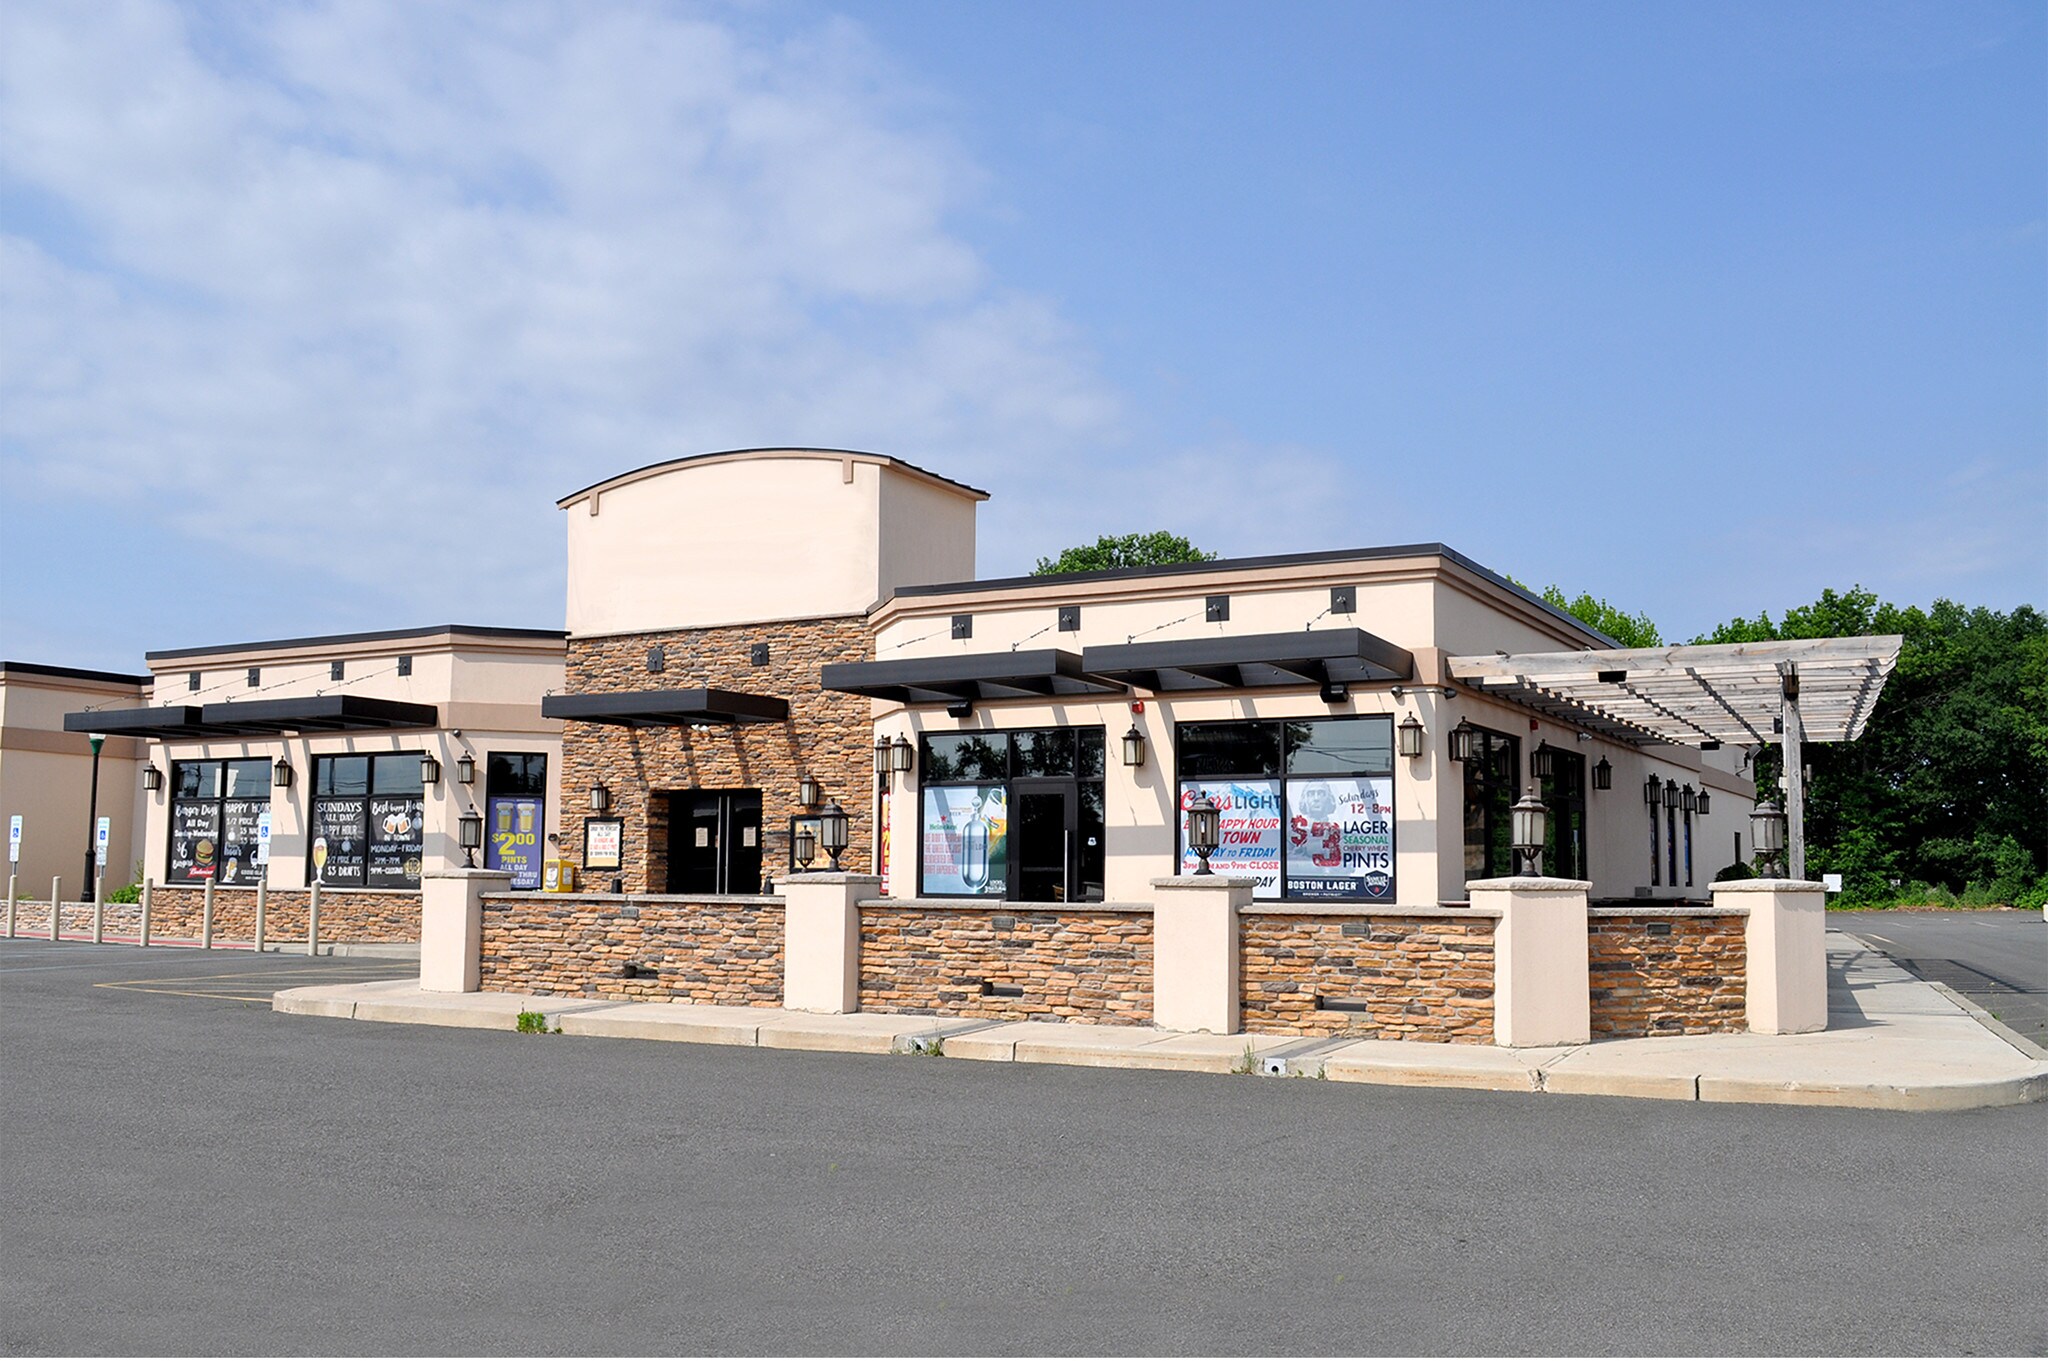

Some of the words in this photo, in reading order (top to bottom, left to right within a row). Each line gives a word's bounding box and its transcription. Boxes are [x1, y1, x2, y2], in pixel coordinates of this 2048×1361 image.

[1339, 788, 1379, 805] Saturdays
[225, 803, 248, 813] HAPPY
[317, 802, 363, 813] SUNDAYS
[371, 801, 389, 815] Best
[1235, 795, 1281, 810] LIGHT
[186, 819, 196, 827] All
[197, 819, 209, 828] Day
[1219, 818, 1248, 830] APPY
[1248, 818, 1279, 829] HOUR
[1343, 820, 1388, 834] LAGER
[320, 825, 340, 835] HAPPY
[341, 825, 358, 835] HOUR
[1222, 831, 1262, 844] TOWN
[1343, 835, 1388, 845] SEASONAL
[1238, 847, 1277, 858] FRIDAY
[501, 855, 528, 864] PINTS
[1343, 852, 1390, 869] PINTS
[1287, 880, 1324, 890] BOSTON
[1326, 882, 1357, 891] LAGER
